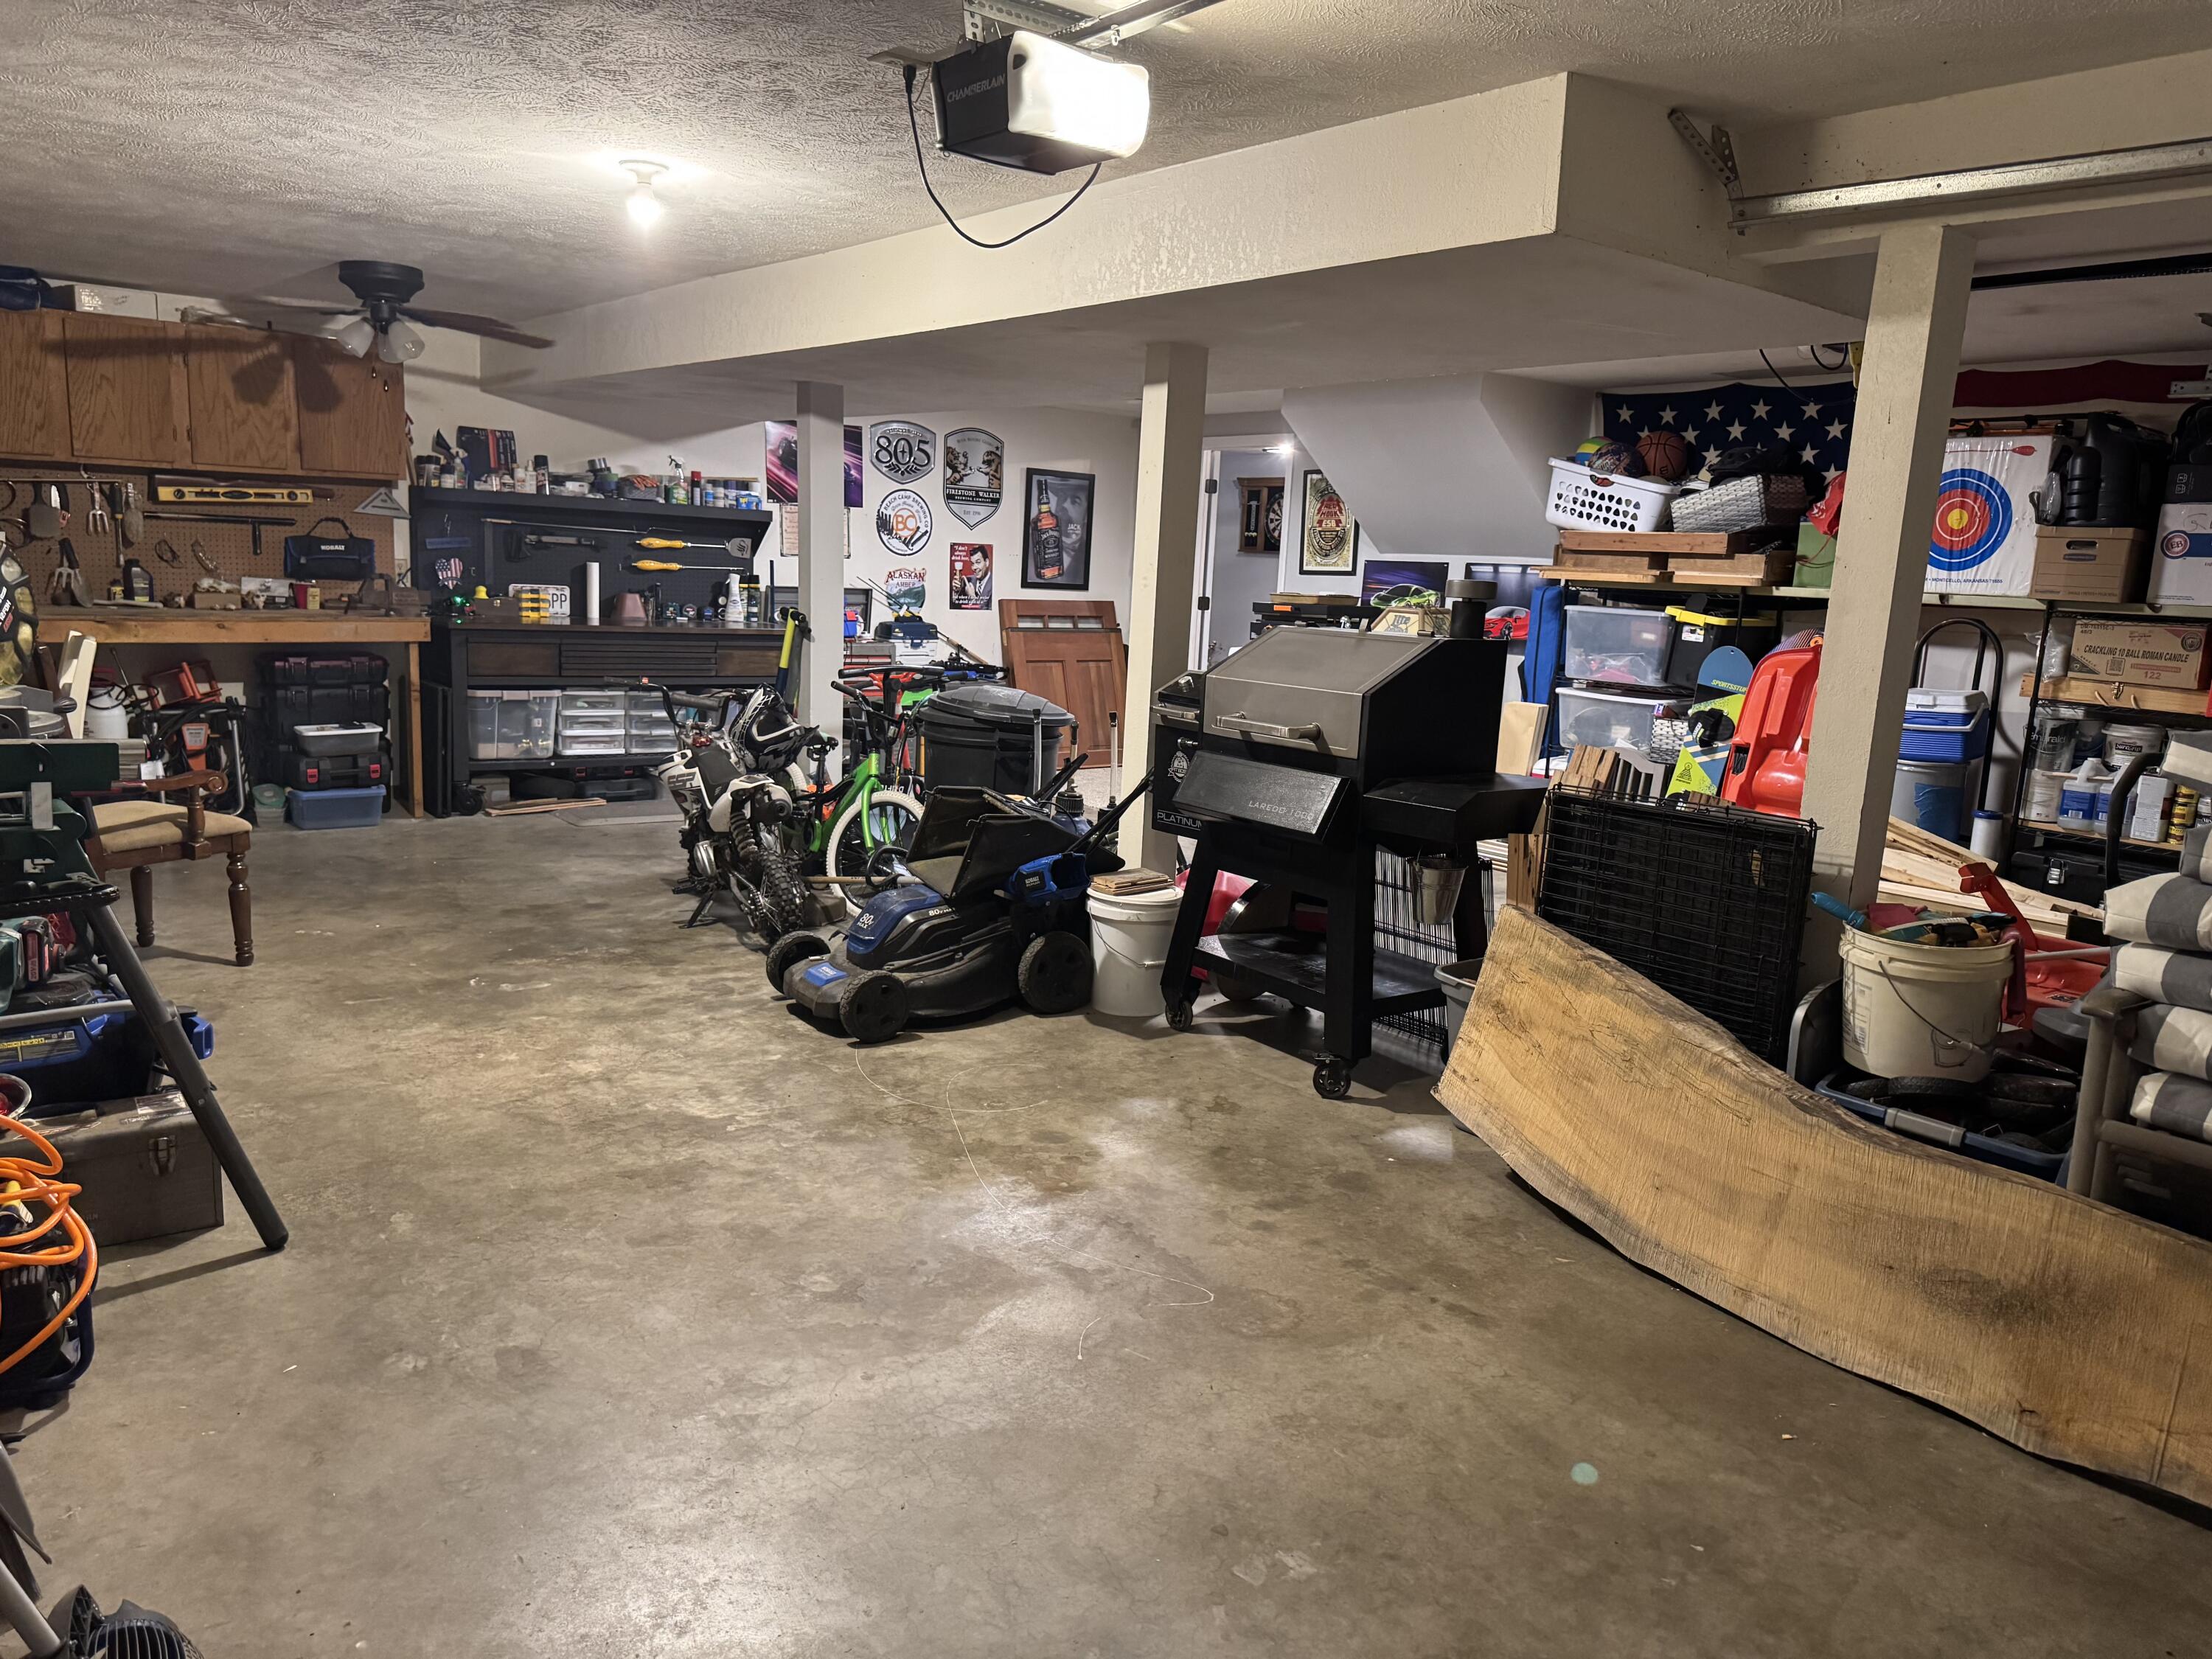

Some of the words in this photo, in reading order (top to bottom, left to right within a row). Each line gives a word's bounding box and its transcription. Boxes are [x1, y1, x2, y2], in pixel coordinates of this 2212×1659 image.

[947, 73, 1006, 102] CHAMBERLAIN
[874, 435, 931, 467] 805
[946, 488, 976, 496] FIRESTONE
[884, 497, 897, 511] BEACH
[911, 497, 928, 519] BREWING
[895, 514, 916, 532] BC
[1321, 519, 1337, 527] ESB
[2170, 540, 2184, 550] EB
[885, 570, 925, 583] ALASKAN
[2084, 644, 2118, 655] CRACKLING
[2118, 648, 2126, 657] 10
[2125, 650, 2140, 659] BALL
[2140, 650, 2164, 661] ROMAN
[2164, 652, 2190, 663] CANDLE
[2143, 670, 2162, 680] 122
[1248, 800, 1288, 814] LAREDO
[857, 921, 869, 930] MAX
